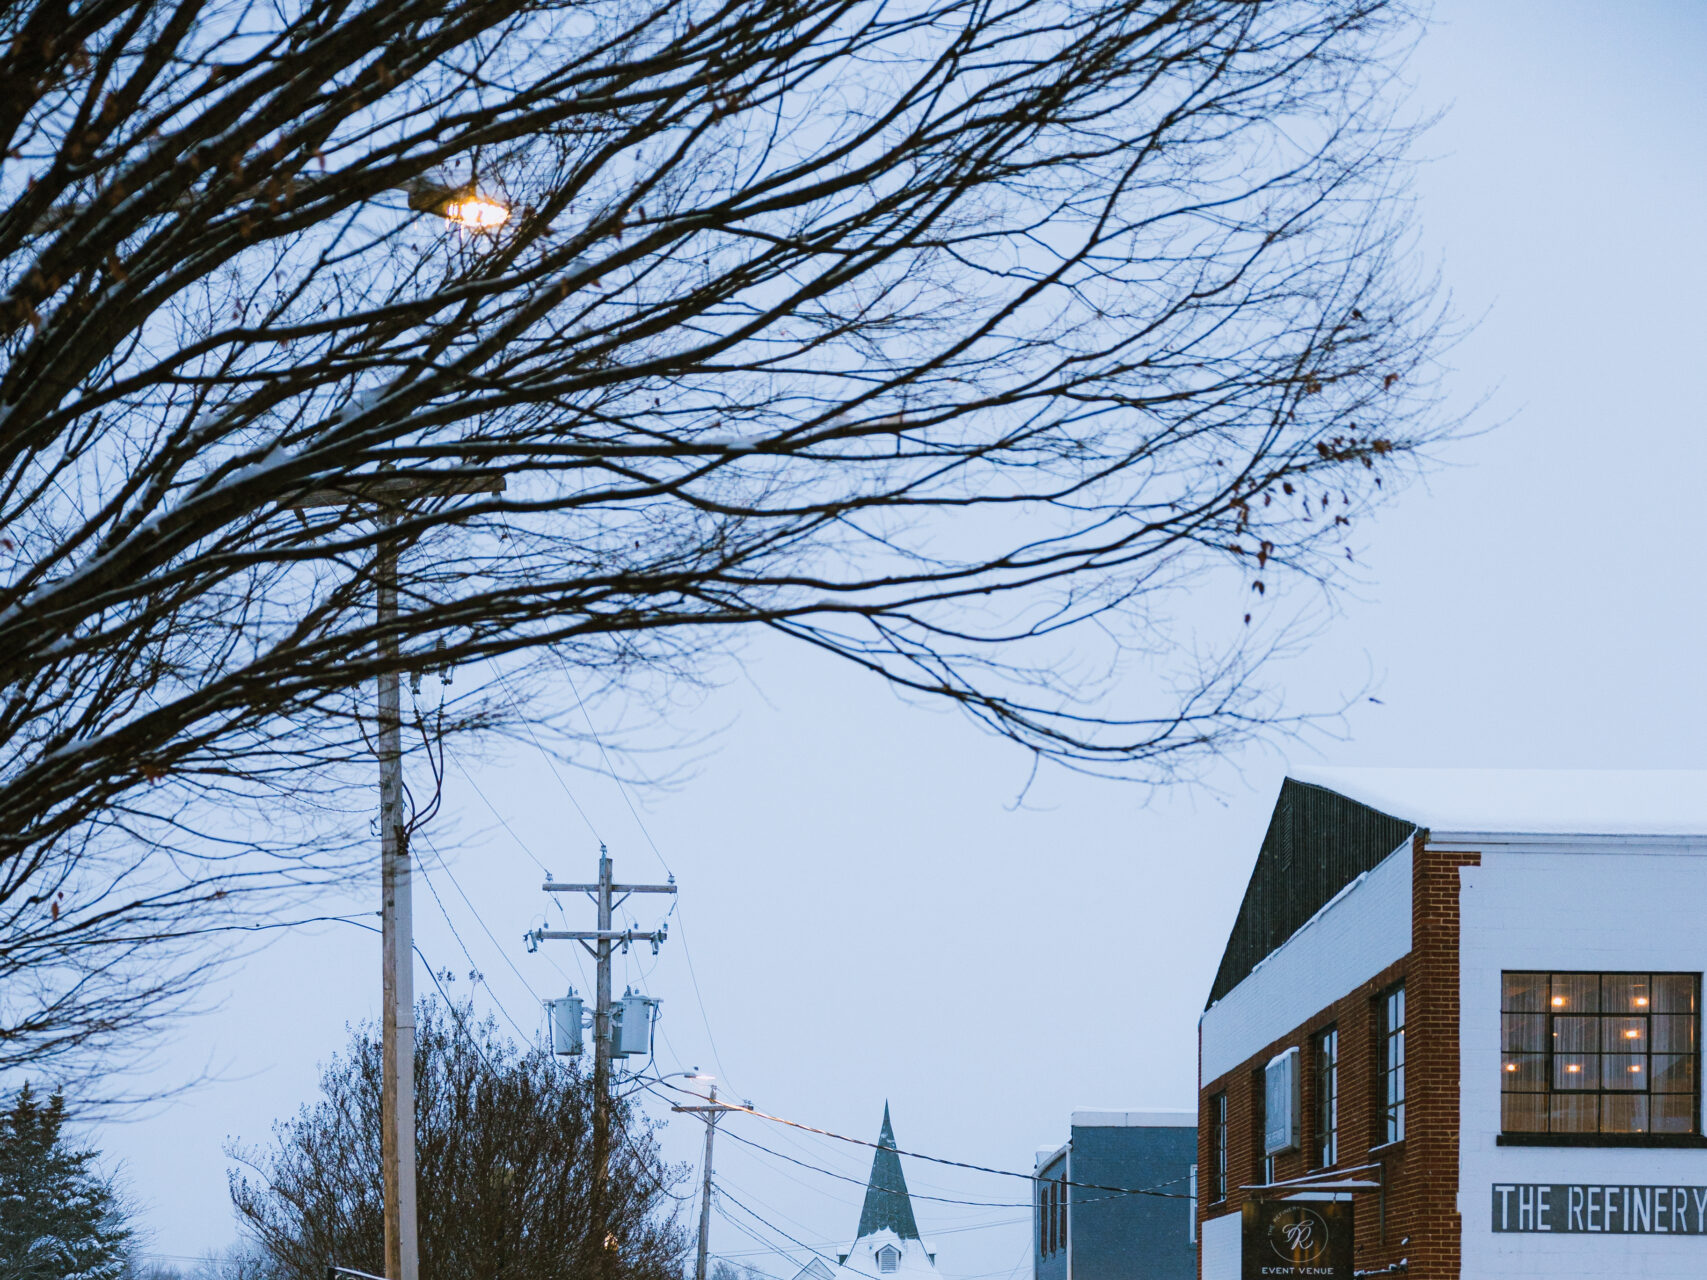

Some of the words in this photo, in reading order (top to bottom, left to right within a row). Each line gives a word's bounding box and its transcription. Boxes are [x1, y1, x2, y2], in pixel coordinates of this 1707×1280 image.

[1495, 1185, 1551, 1231] THE
[1566, 1186, 1707, 1233] REFINERY
[1261, 1266, 1295, 1275] EVENT
[1298, 1266, 1335, 1275] VENUE
